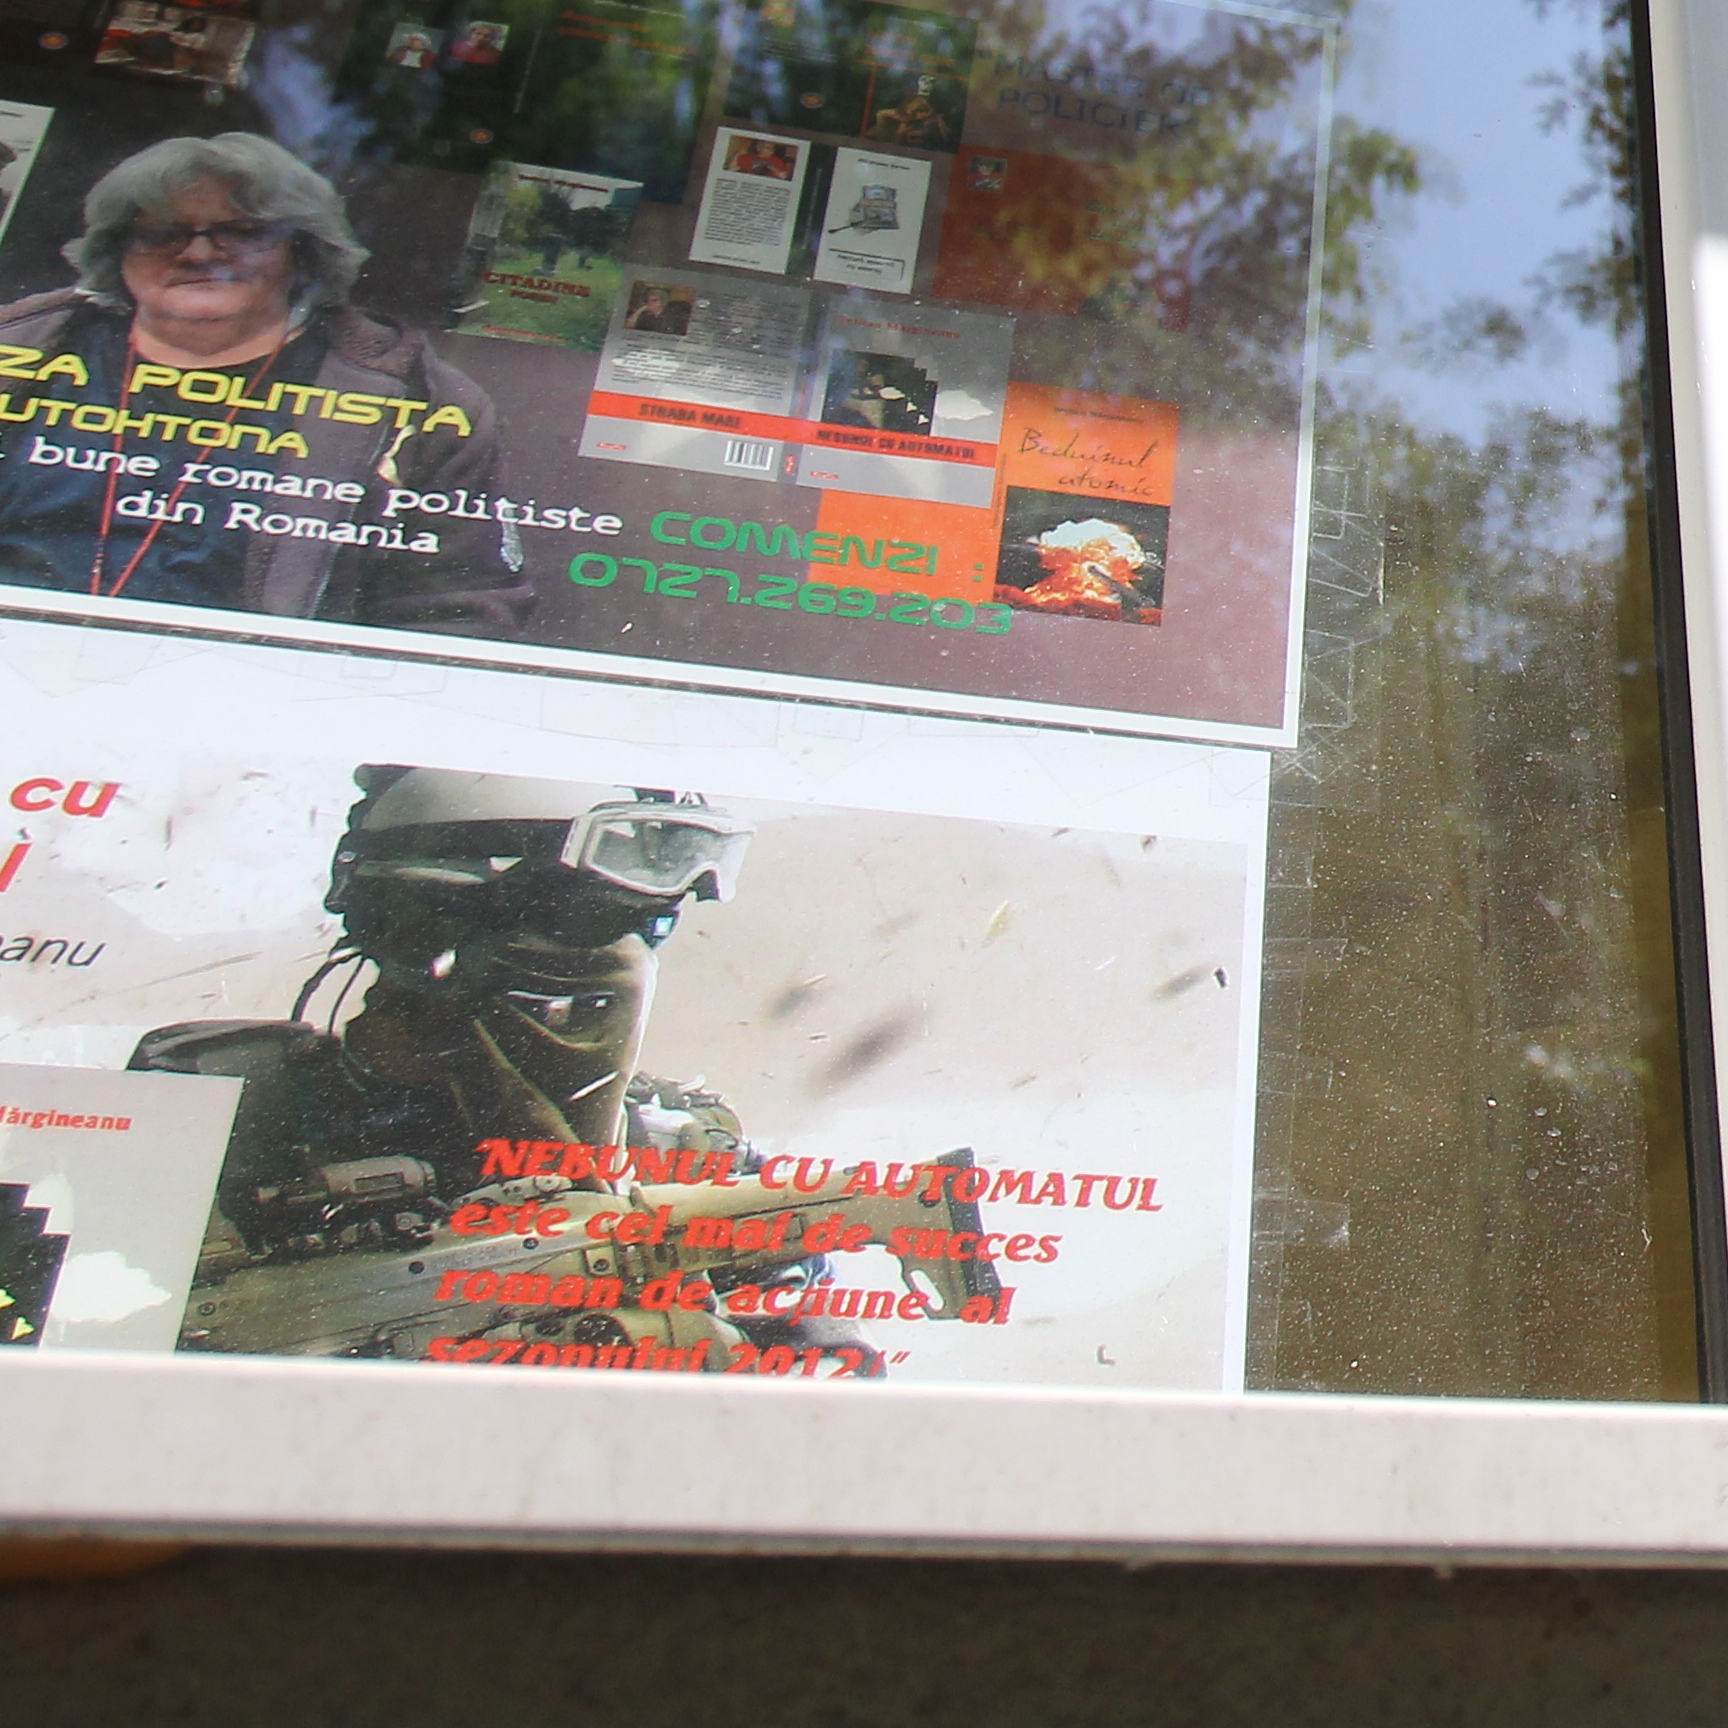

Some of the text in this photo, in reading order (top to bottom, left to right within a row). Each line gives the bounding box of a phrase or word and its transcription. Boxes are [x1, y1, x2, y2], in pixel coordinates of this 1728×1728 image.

[127, 362, 473, 439] POLITISTA
[28, 435, 625, 538] bune romane politiste
[115, 489, 442, 556] din Romania
[649, 510, 940, 577] COMENZI
[567, 551, 1016, 636] 0727.269.203
[9, 776, 122, 819] cu
[0, 934, 108, 968] anu
[758, 1153, 834, 1195] CU
[840, 1160, 1165, 1213] AUTOMATUL
[449, 1198, 1064, 1265] este cel mai de succes
[432, 1268, 625, 1312] roman
[639, 1269, 711, 1313] de
[958, 1286, 1018, 1326] al
